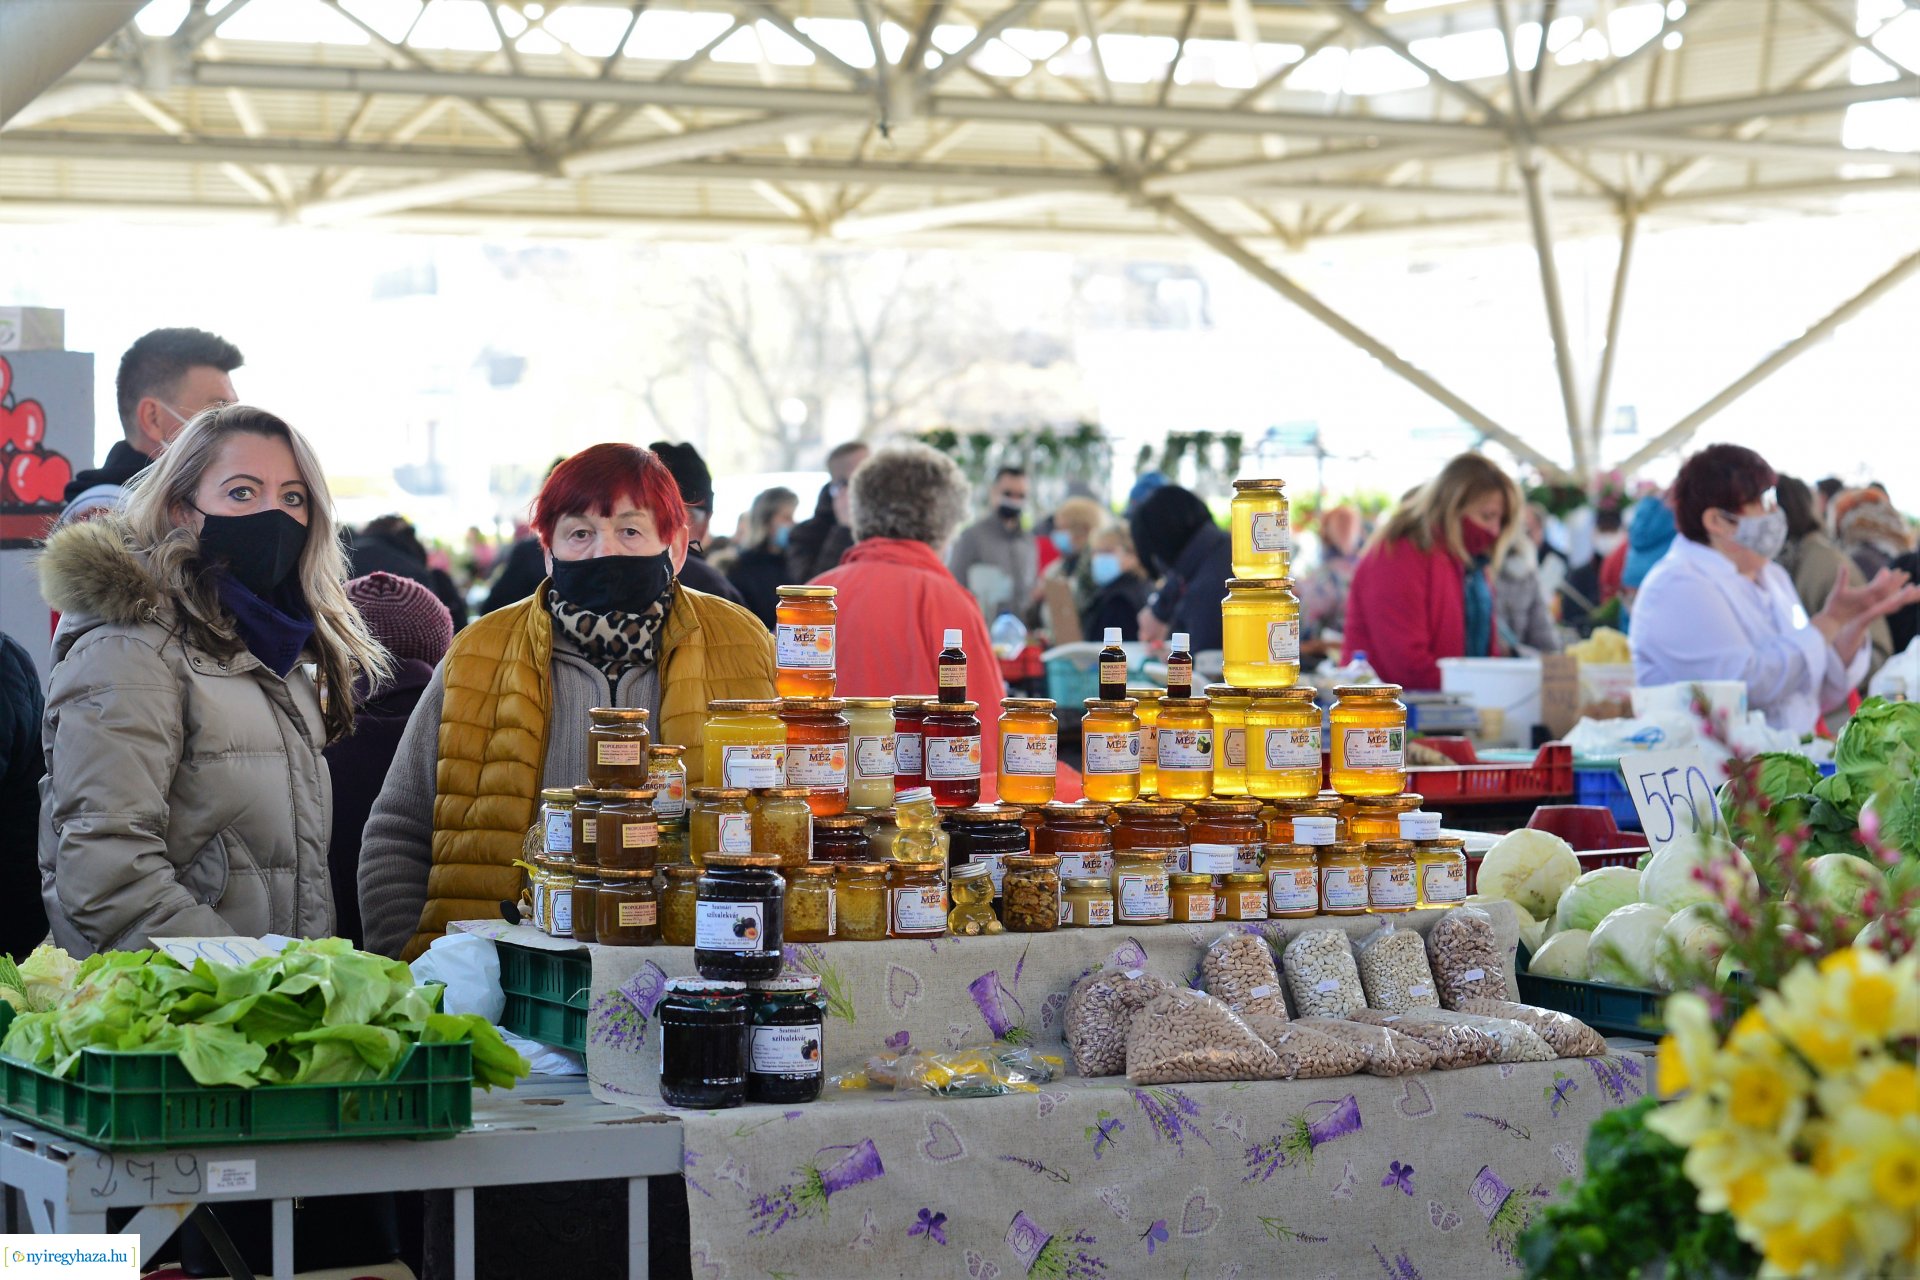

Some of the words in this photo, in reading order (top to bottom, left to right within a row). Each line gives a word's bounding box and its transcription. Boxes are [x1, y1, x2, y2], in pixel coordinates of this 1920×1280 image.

[793, 632, 816, 642] MÉZ
[1175, 734, 1197, 745] MÉZ
[1290, 734, 1310, 743] MÉZ
[1367, 735, 1388, 744] MÉZ
[949, 743, 970, 753] MÉZ
[1026, 741, 1047, 750] MÉZ
[1106, 739, 1128, 749] MÉZ
[809, 752, 831, 761] MÉZ
[1640, 766, 1718, 842] 550
[1237, 851, 1256, 860] MÉZ
[1082, 858, 1102, 868] MÉZ
[1390, 872, 1410, 881] MÉZ
[1447, 868, 1464, 878] MÉZ
[1294, 875, 1313, 886] MÉZ
[1348, 873, 1365, 883] MÉZ
[1145, 883, 1164, 892] MÉZ
[921, 894, 941, 904] MÉZ
[1242, 901, 1262, 909] MÉZ
[707, 911, 739, 919] szilvalekvár
[1090, 907, 1110, 916] MÉZ
[772, 1034, 806, 1042] szilvalekvár
[90, 1152, 202, 1200] 279
